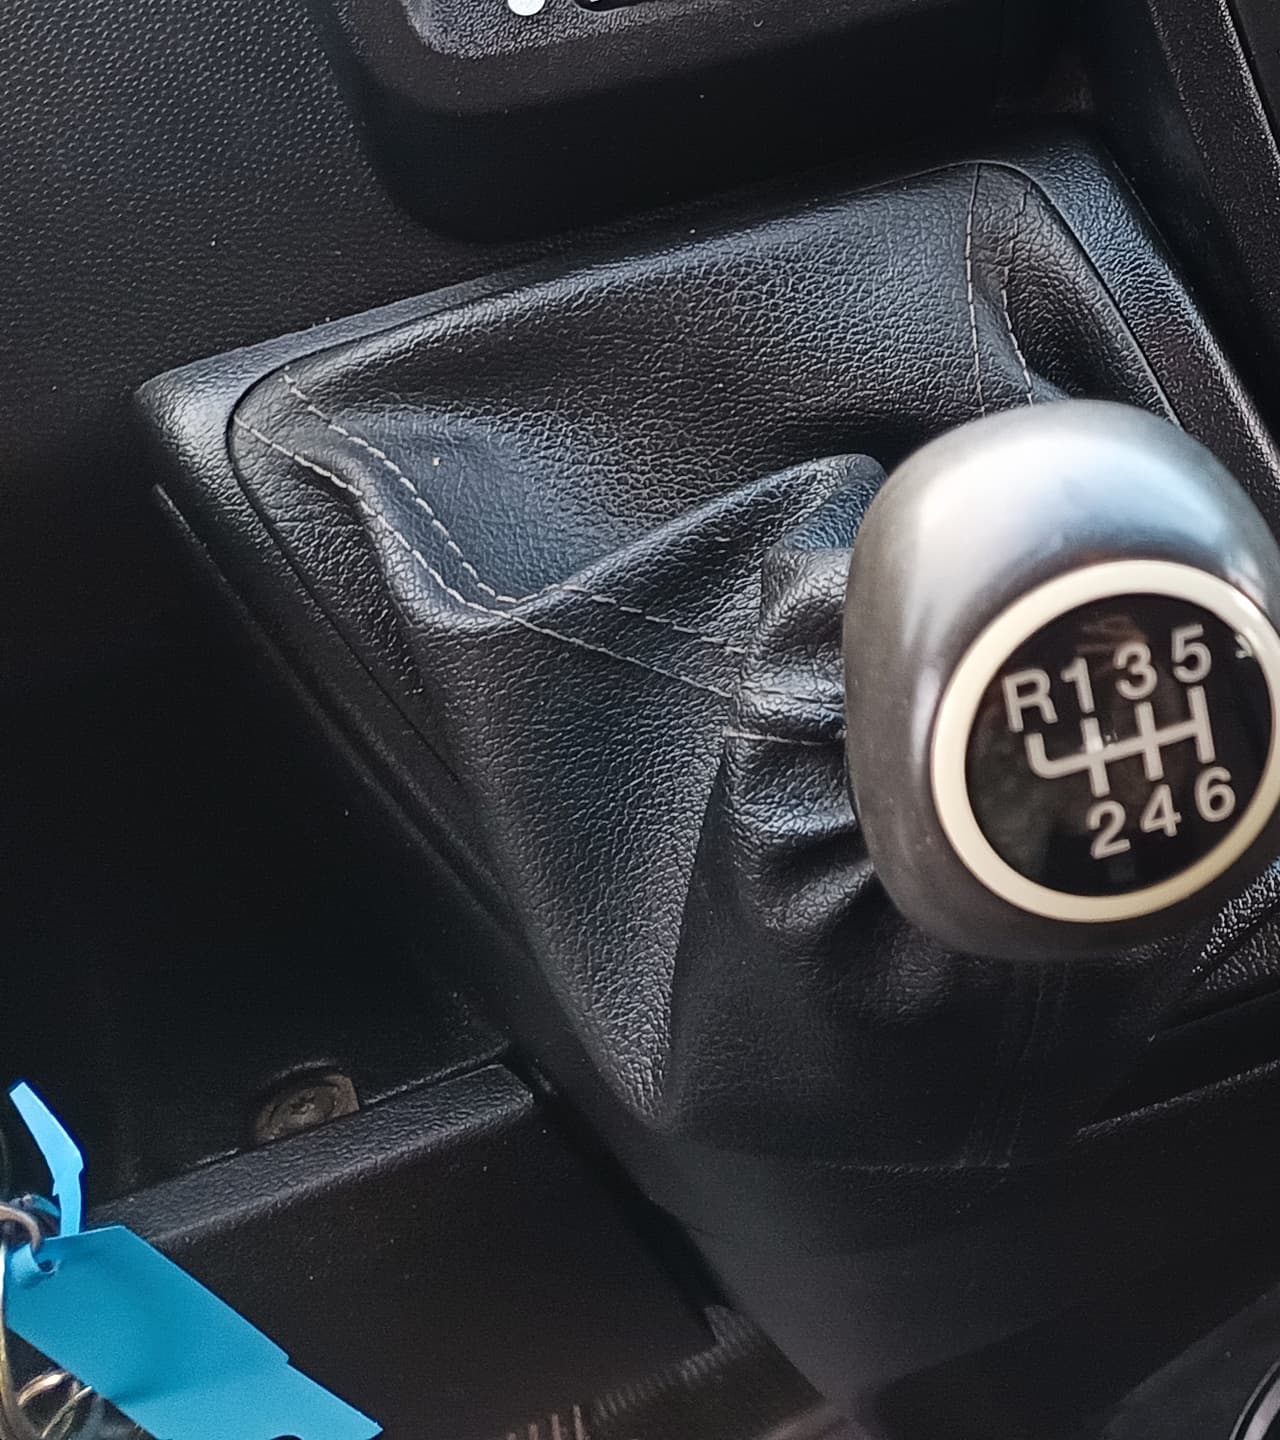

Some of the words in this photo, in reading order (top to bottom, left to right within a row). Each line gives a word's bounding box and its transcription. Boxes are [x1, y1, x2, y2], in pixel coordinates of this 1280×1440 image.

[1113, 643, 1159, 701] 3
[1171, 624, 1212, 684] 5
[1086, 800, 1131, 859] 2
[1140, 785, 1182, 838] 4
[1195, 766, 1236, 823] 6
